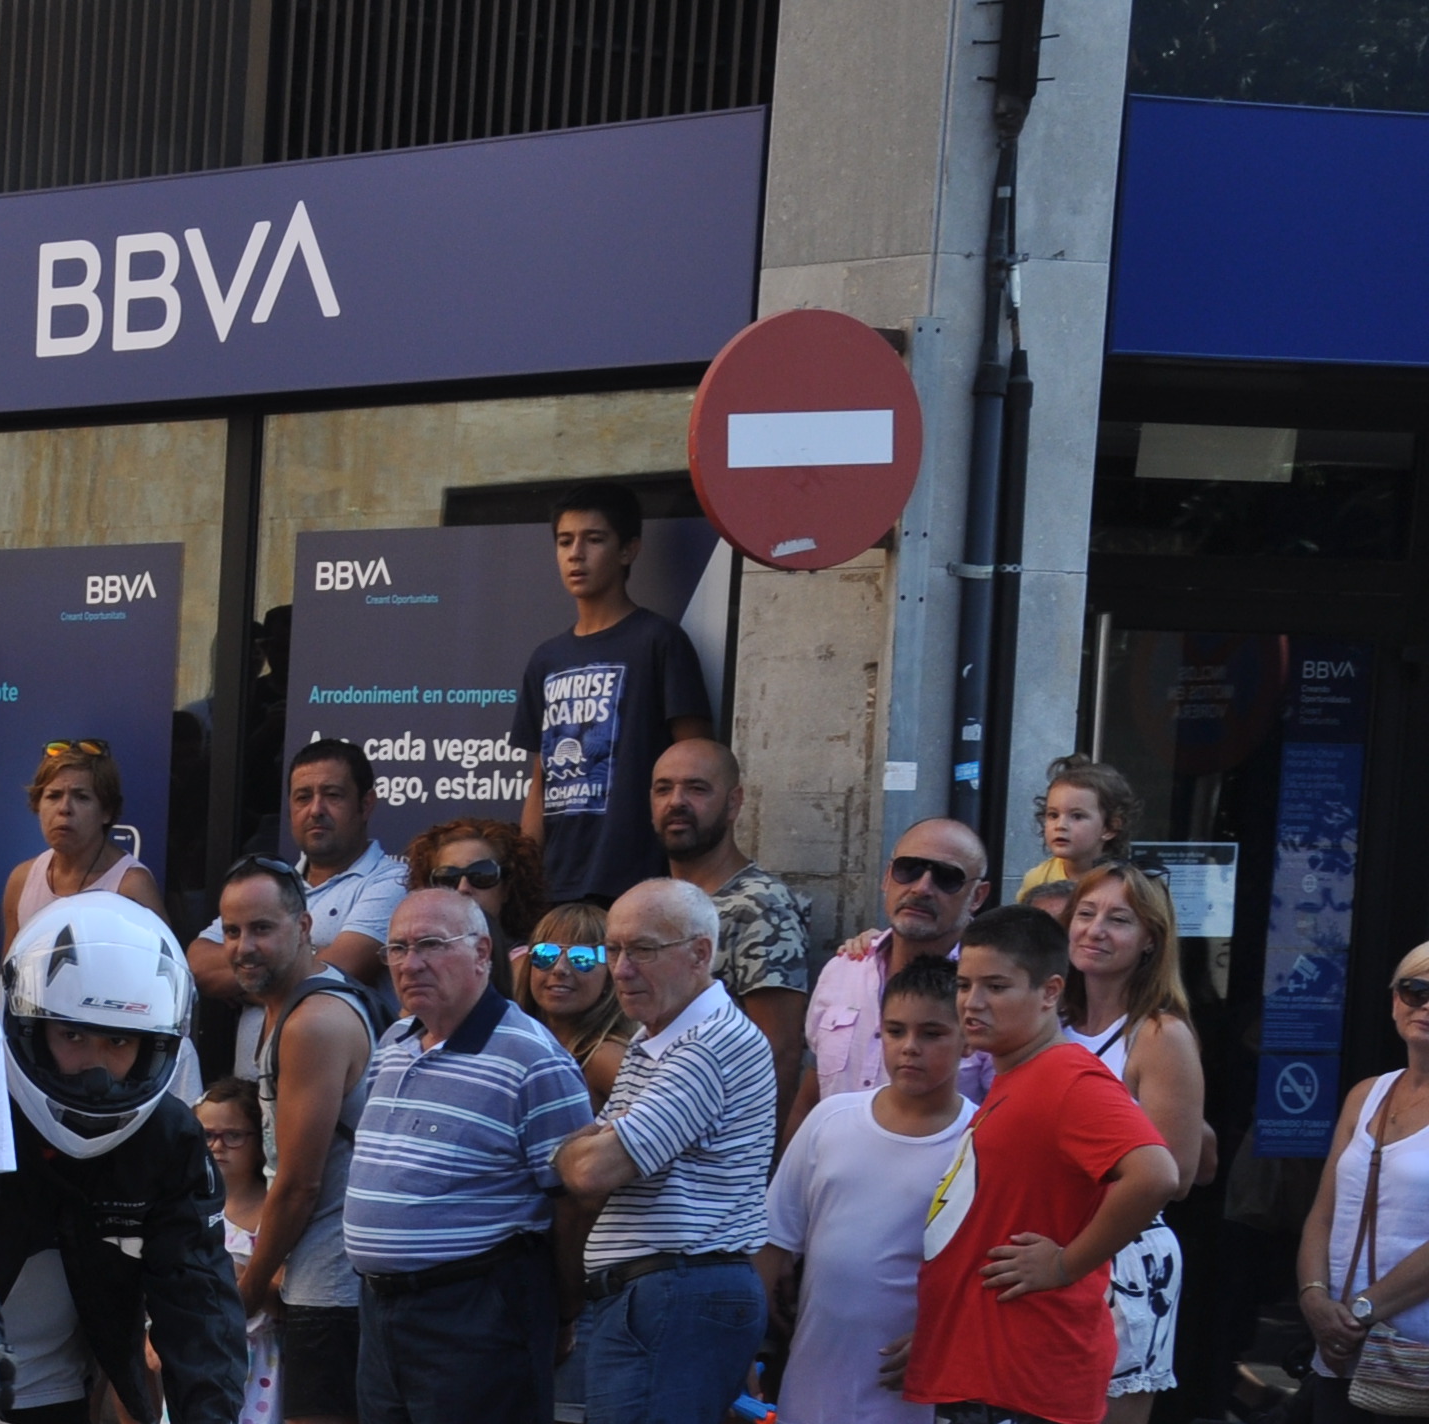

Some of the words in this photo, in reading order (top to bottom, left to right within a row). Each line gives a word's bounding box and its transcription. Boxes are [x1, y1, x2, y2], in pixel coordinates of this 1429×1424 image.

[35, 199, 341, 358] BBVA
[86, 570, 157, 605] BBVA
[314, 556, 393, 591] BBVA
[1301, 660, 1355, 679] BBVA
[309, 685, 419, 704] Arrodoniment
[423, 687, 442, 703] en
[446, 687, 518, 707] compres
[544, 672, 616, 704] SUNRISE
[363, 731, 426, 761] cada
[371, 774, 429, 807] ago,
[82, 997, 150, 1013] LS2
[1257, 1119, 1301, 1128] PROHIBIDO
[1303, 1120, 1330, 1129] FUMAR
